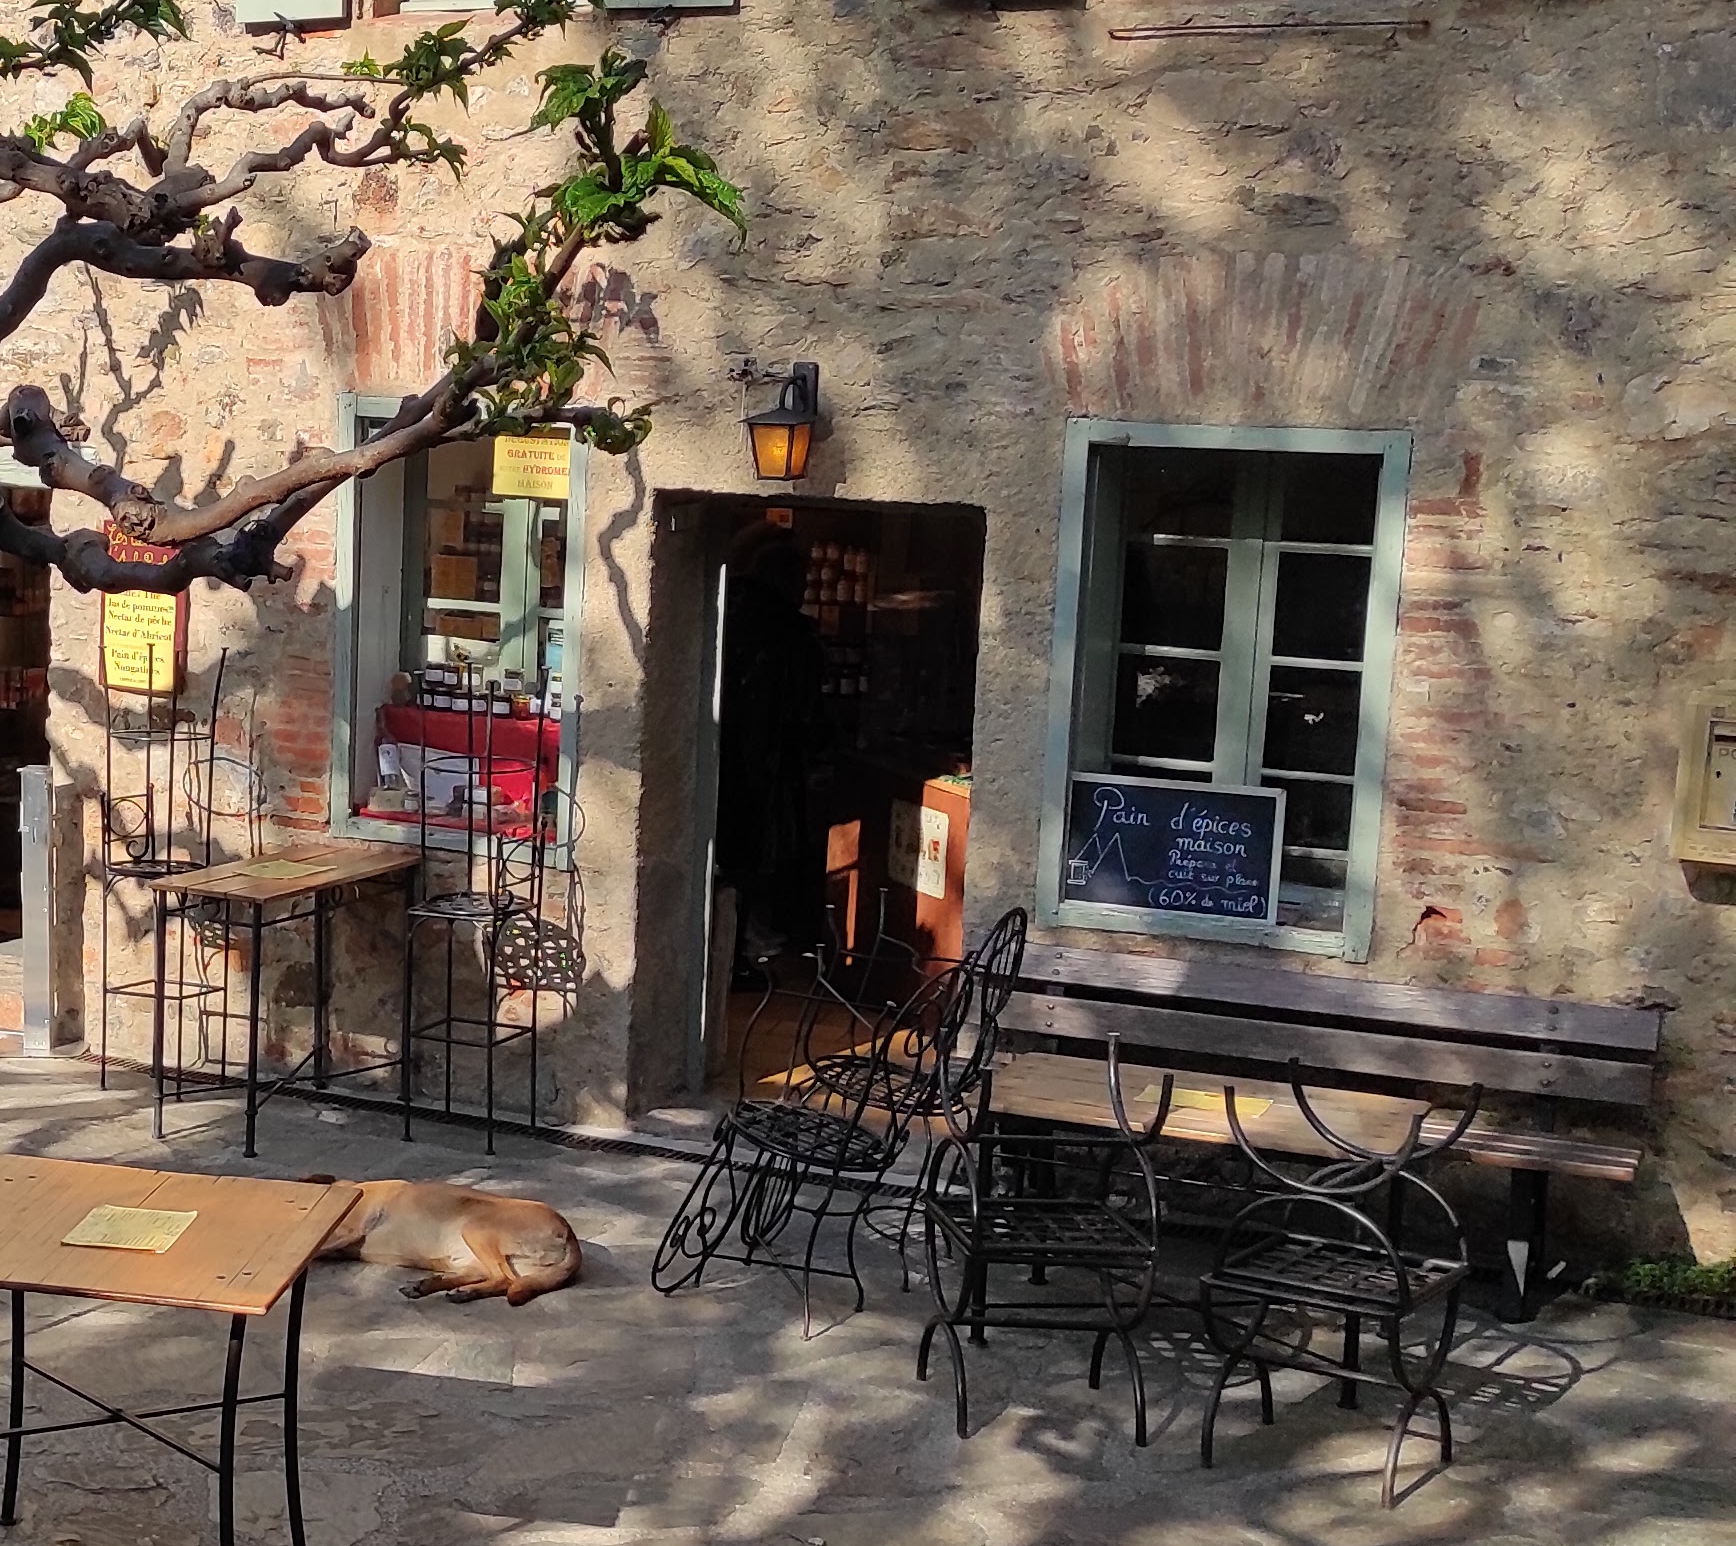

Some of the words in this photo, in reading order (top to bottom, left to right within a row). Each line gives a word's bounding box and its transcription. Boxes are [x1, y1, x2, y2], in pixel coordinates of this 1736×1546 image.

[507, 449, 555, 460] GRATUITE
[517, 479, 553, 490] MAISON
[108, 609, 132, 622] Nectar
[134, 613, 145, 623] de
[105, 625, 131, 637] Nectar
[111, 648, 130, 660] Pain
[1093, 786, 1151, 831] Pain
[1170, 801, 1253, 839] d'épices
[1175, 836, 1247, 858] maison
[1168, 868, 1194, 880] cuit
[1200, 873, 1220, 883] sur
